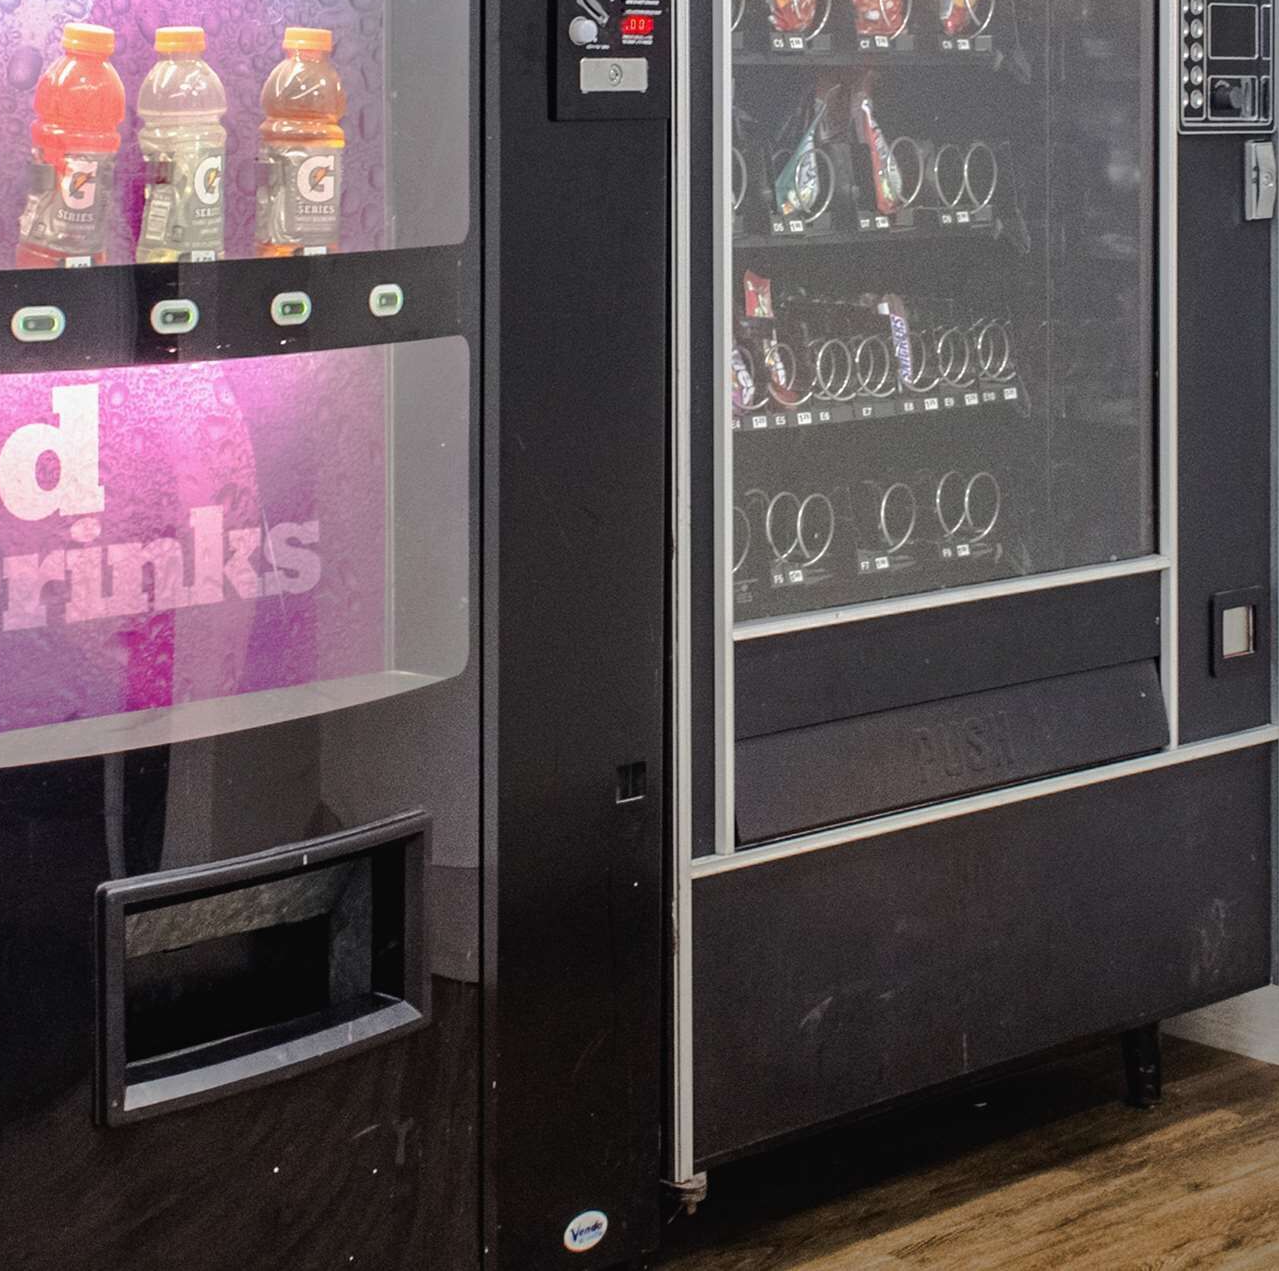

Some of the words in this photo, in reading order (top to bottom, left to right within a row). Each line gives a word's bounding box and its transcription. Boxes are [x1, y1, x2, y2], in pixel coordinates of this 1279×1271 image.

[60, 159, 98, 209] G
[194, 156, 221, 205] G
[297, 155, 335, 202] G
[57, 208, 94, 223] SERIES
[298, 204, 335, 215] SERIES
